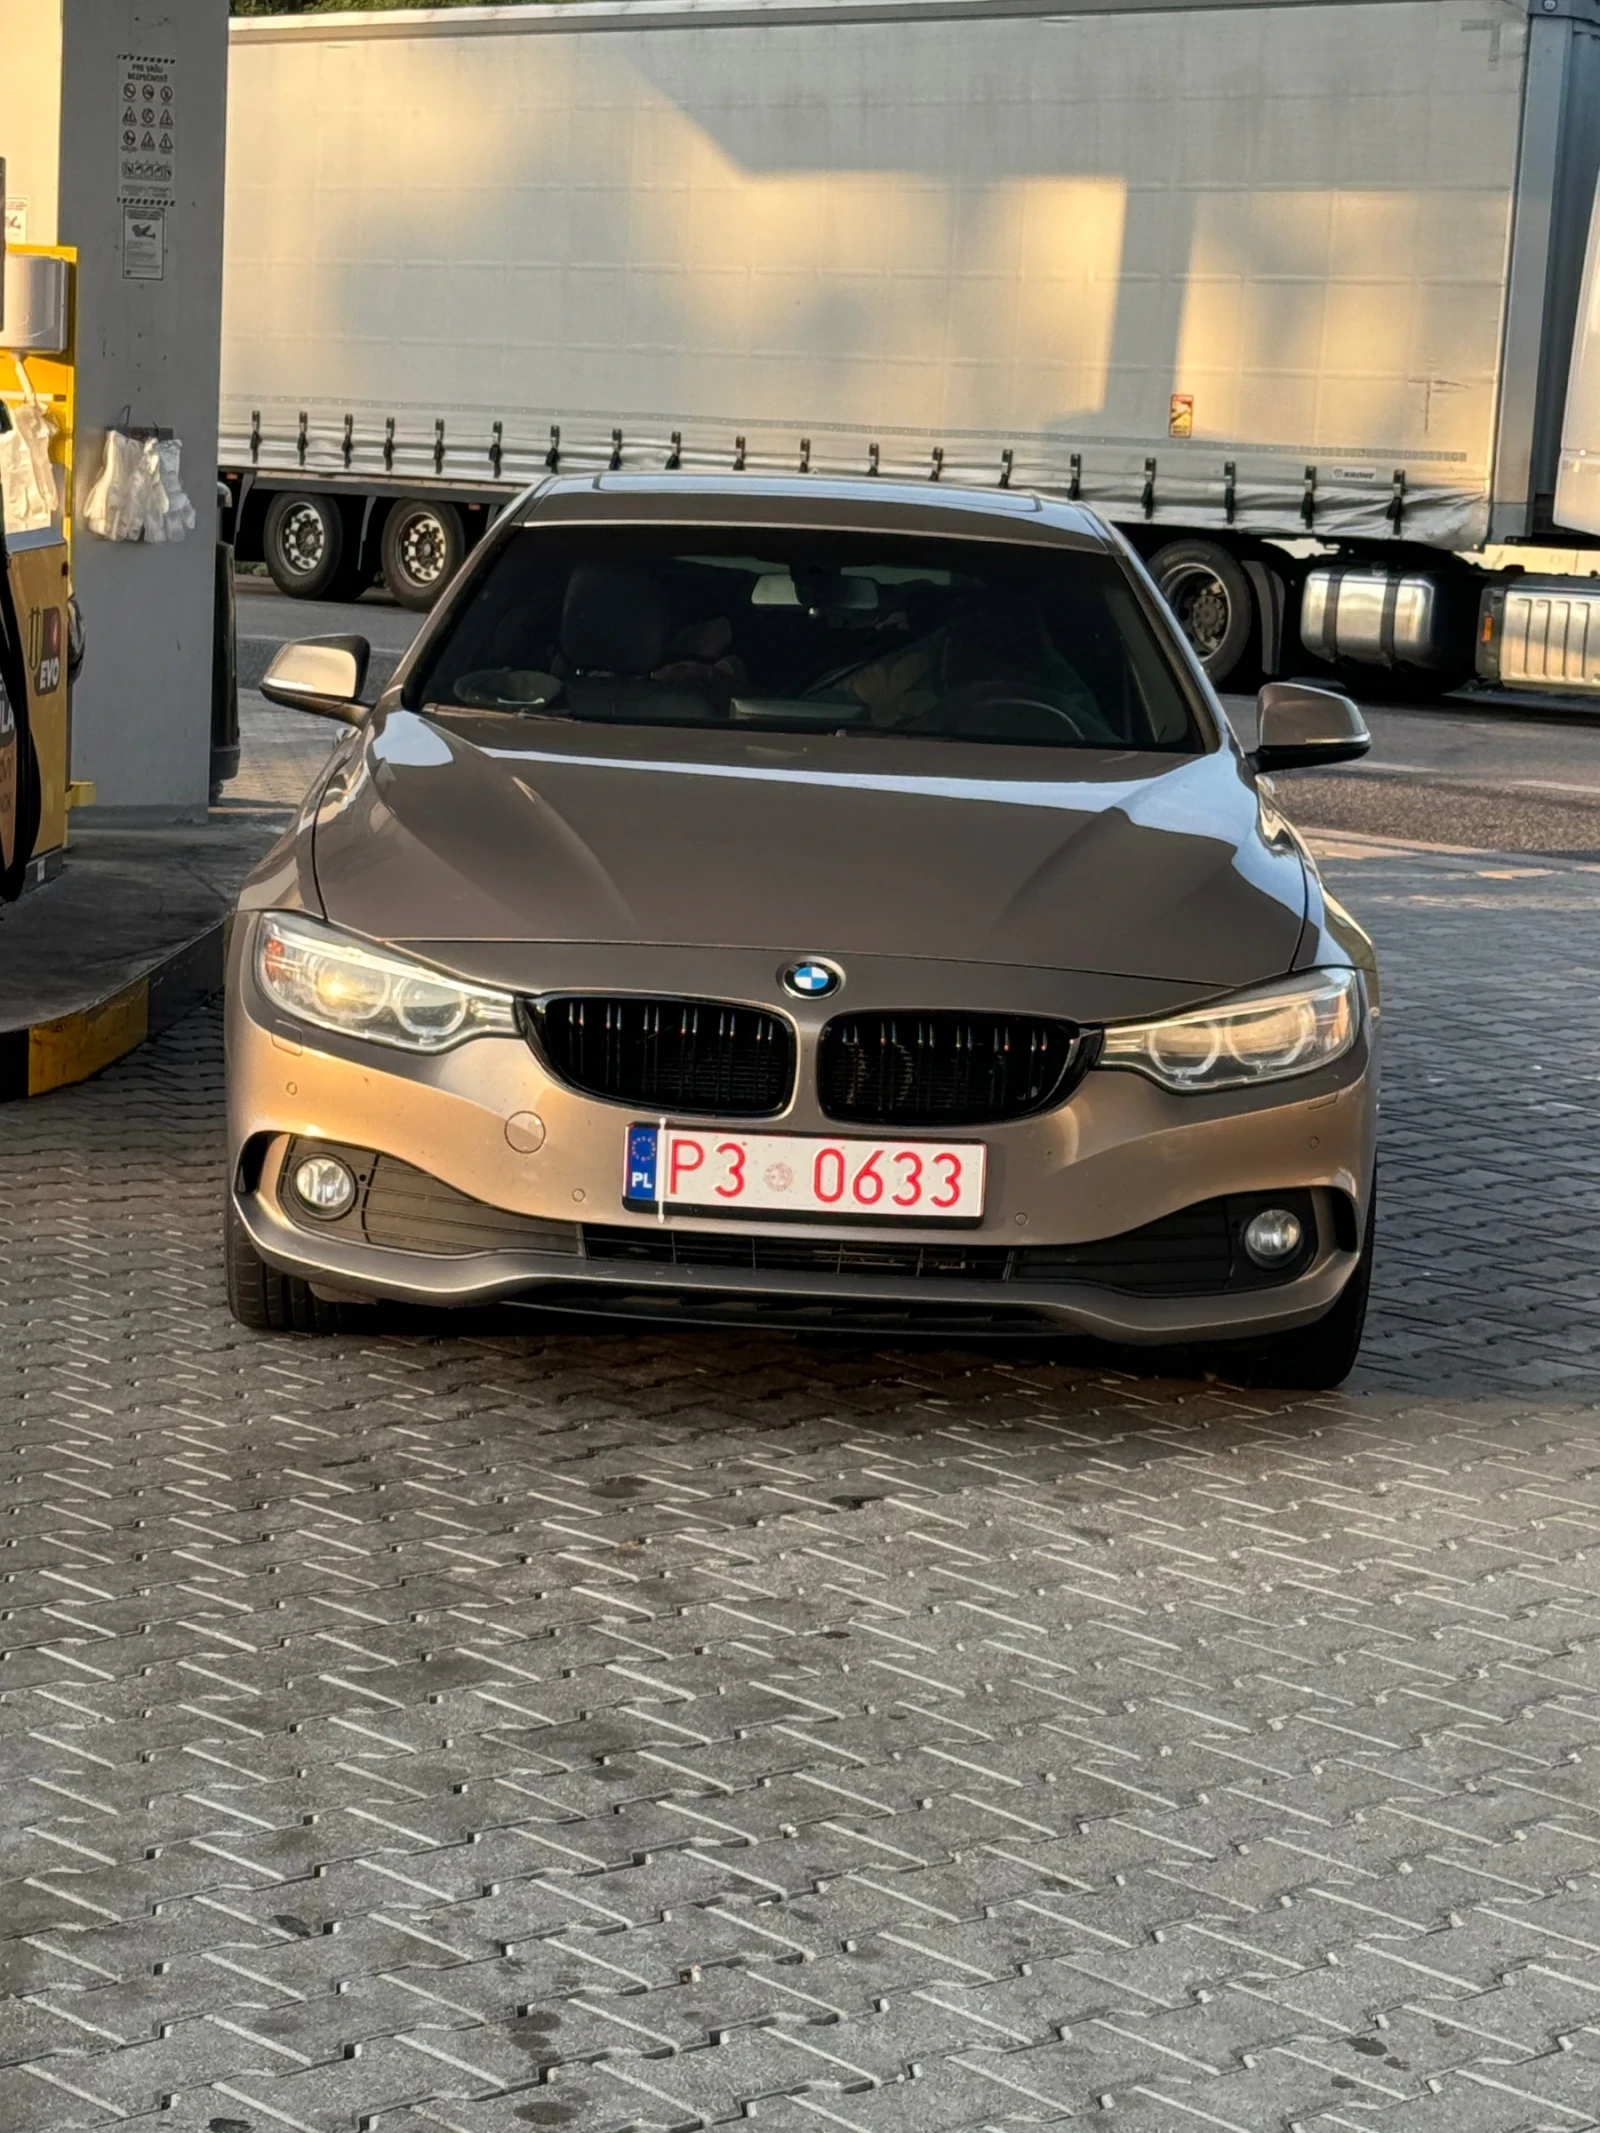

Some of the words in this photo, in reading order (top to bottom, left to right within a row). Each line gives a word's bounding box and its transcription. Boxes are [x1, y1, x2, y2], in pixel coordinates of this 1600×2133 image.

[40, 656, 60, 689] EVO
[631, 1171, 653, 1189] PL
[670, 1138, 746, 1197] P3
[813, 1147, 962, 1207] 0633
